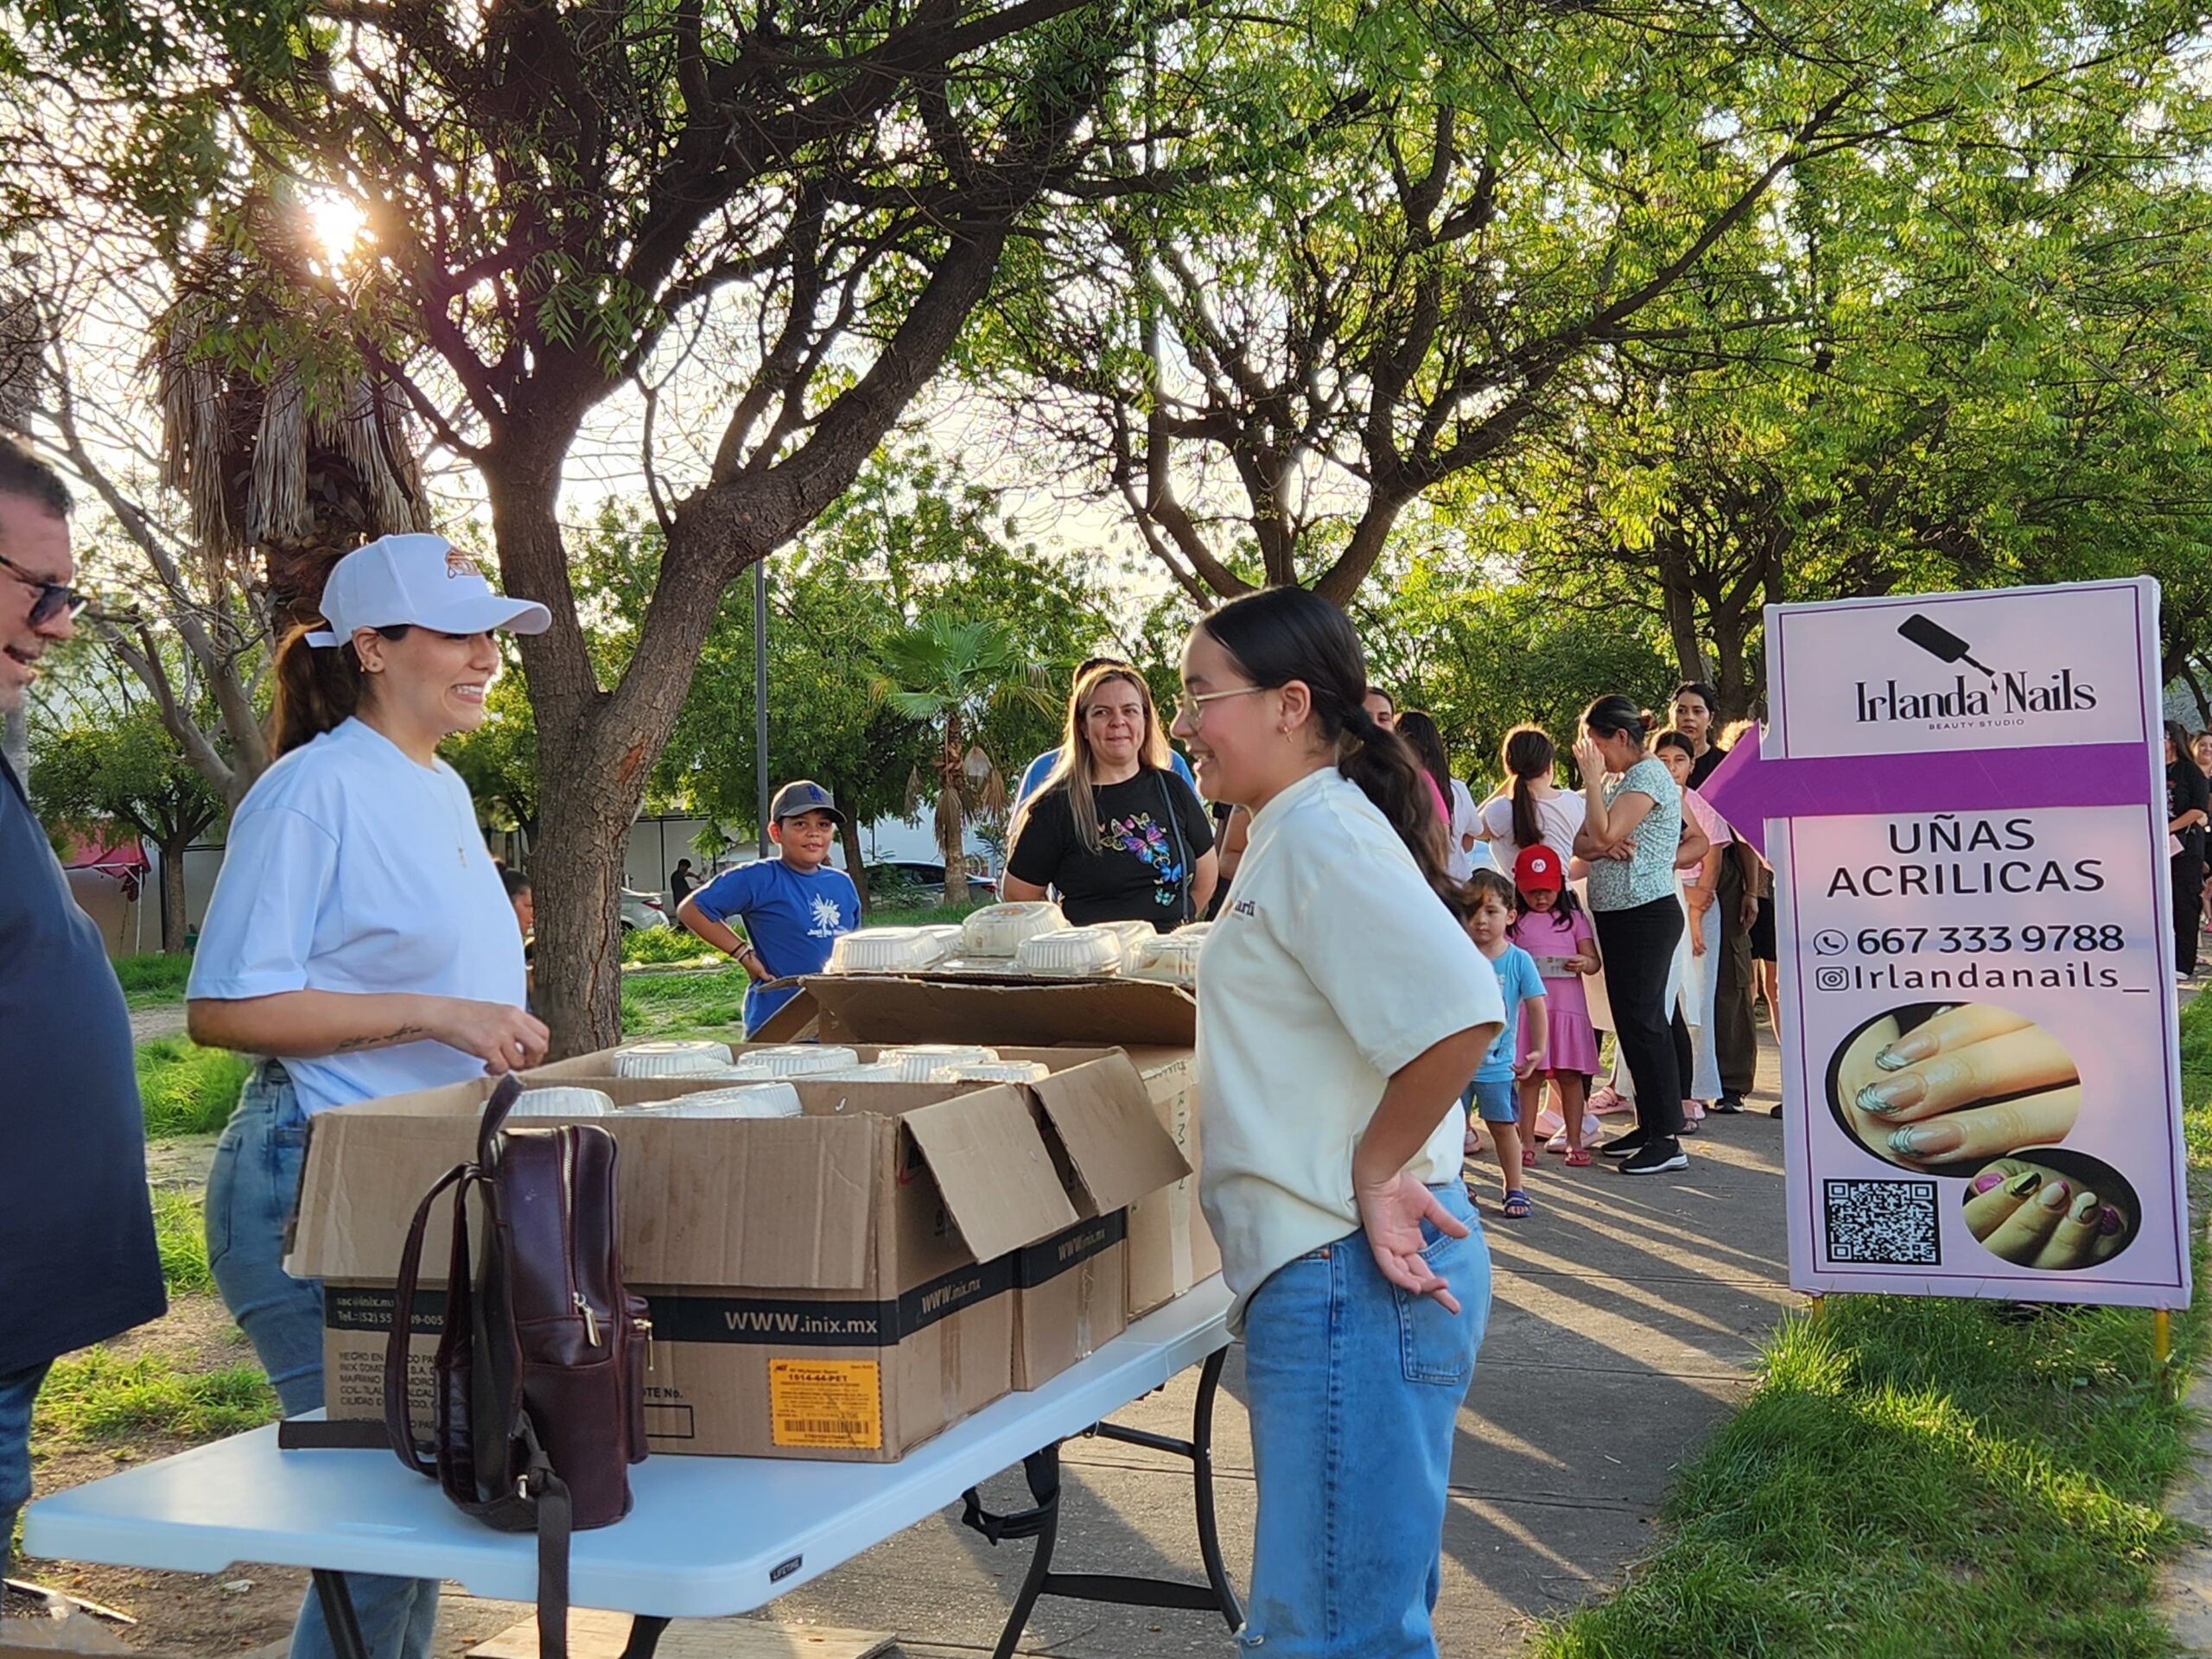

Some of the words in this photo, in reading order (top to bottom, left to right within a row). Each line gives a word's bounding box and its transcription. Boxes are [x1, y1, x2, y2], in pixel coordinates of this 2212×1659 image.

[1855, 675, 1989, 722] Irlanda
[2002, 668, 2097, 715] Nails
[1929, 721, 1974, 730] BEAUTY
[1979, 718, 2024, 728] STUDIO
[1889, 814, 2035, 854] UÑAS
[1827, 860, 2105, 898] ACRILICAS
[1857, 927, 1929, 956] 667
[1938, 926, 2012, 953] 333
[2021, 924, 2125, 952] 9788
[1855, 962, 2151, 994] Irlandanails_
[725, 1311, 878, 1334] WWW.inix.mx
